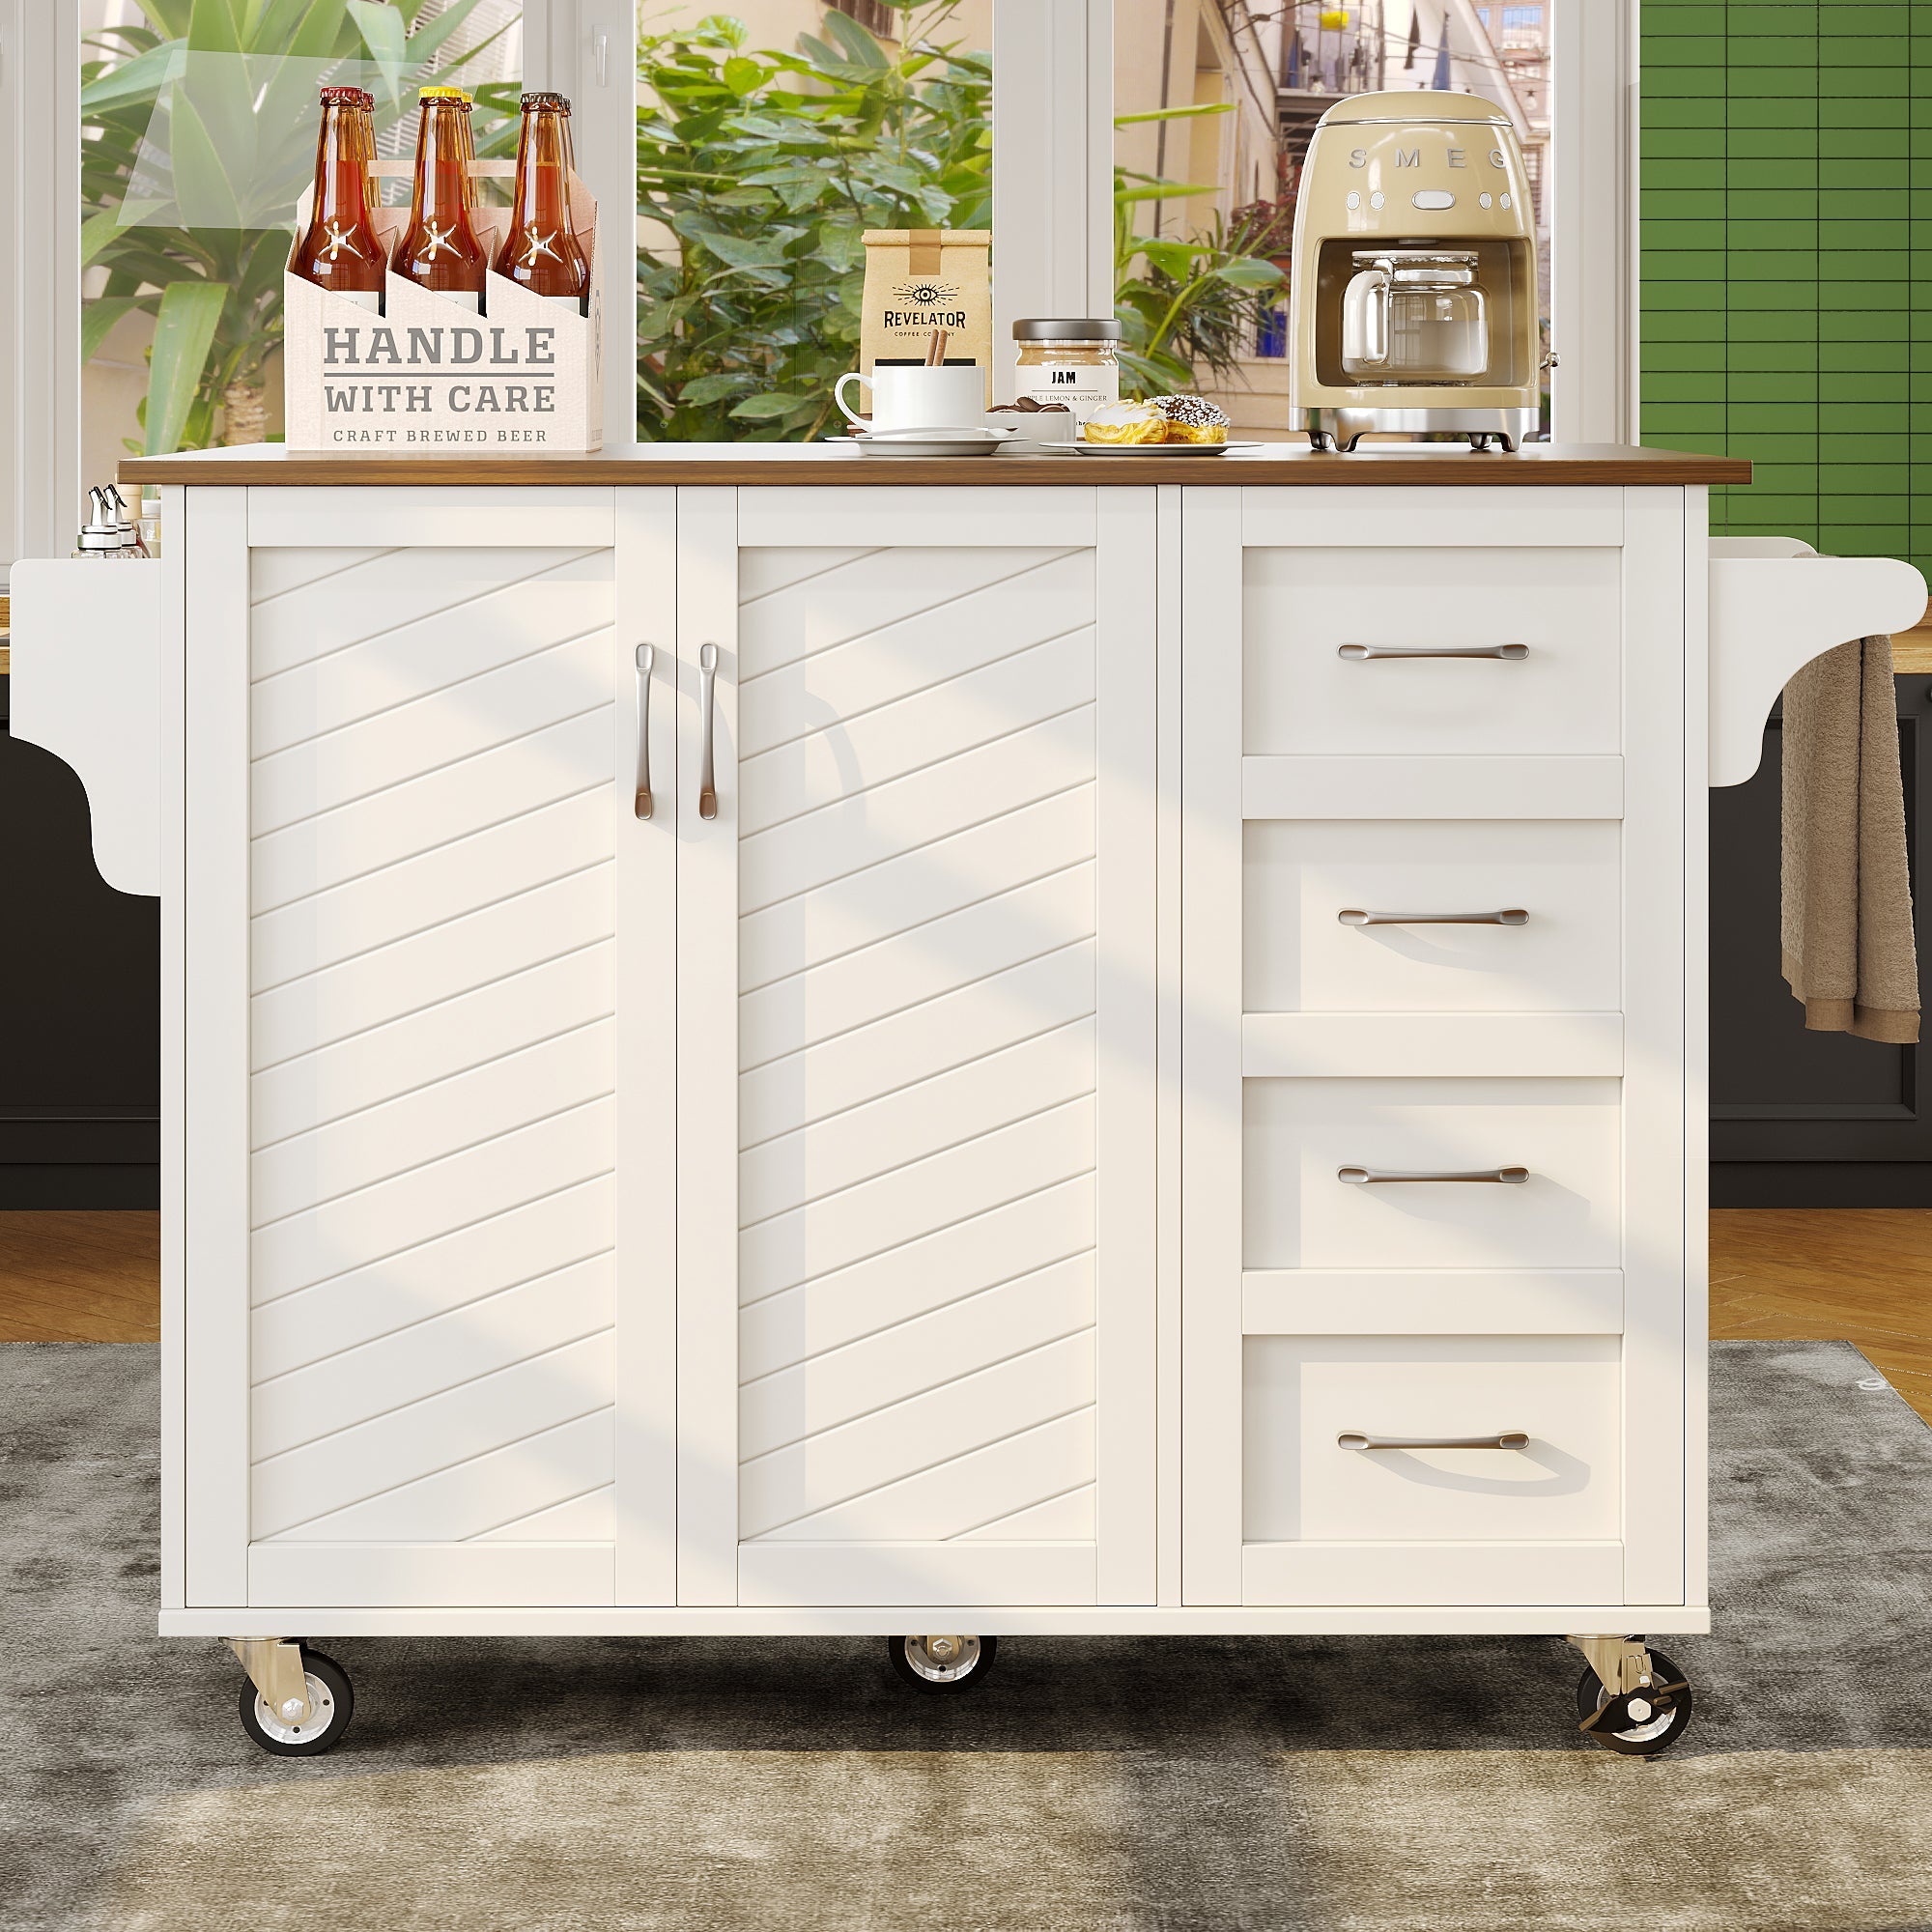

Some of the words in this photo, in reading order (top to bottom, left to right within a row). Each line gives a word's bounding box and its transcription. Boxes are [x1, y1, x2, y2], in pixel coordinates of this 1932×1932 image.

[1349, 148, 1507, 168] SMEG
[884, 310, 966, 328] REVELATOR
[324, 327, 555, 364] HANDLE
[1051, 371, 1076, 384] JAM
[324, 385, 433, 412] WITH
[448, 385, 555, 412] CARE
[333, 430, 398, 442] CRAFT
[406, 430, 488, 442] BREWED
[497, 430, 548, 442] BEER
